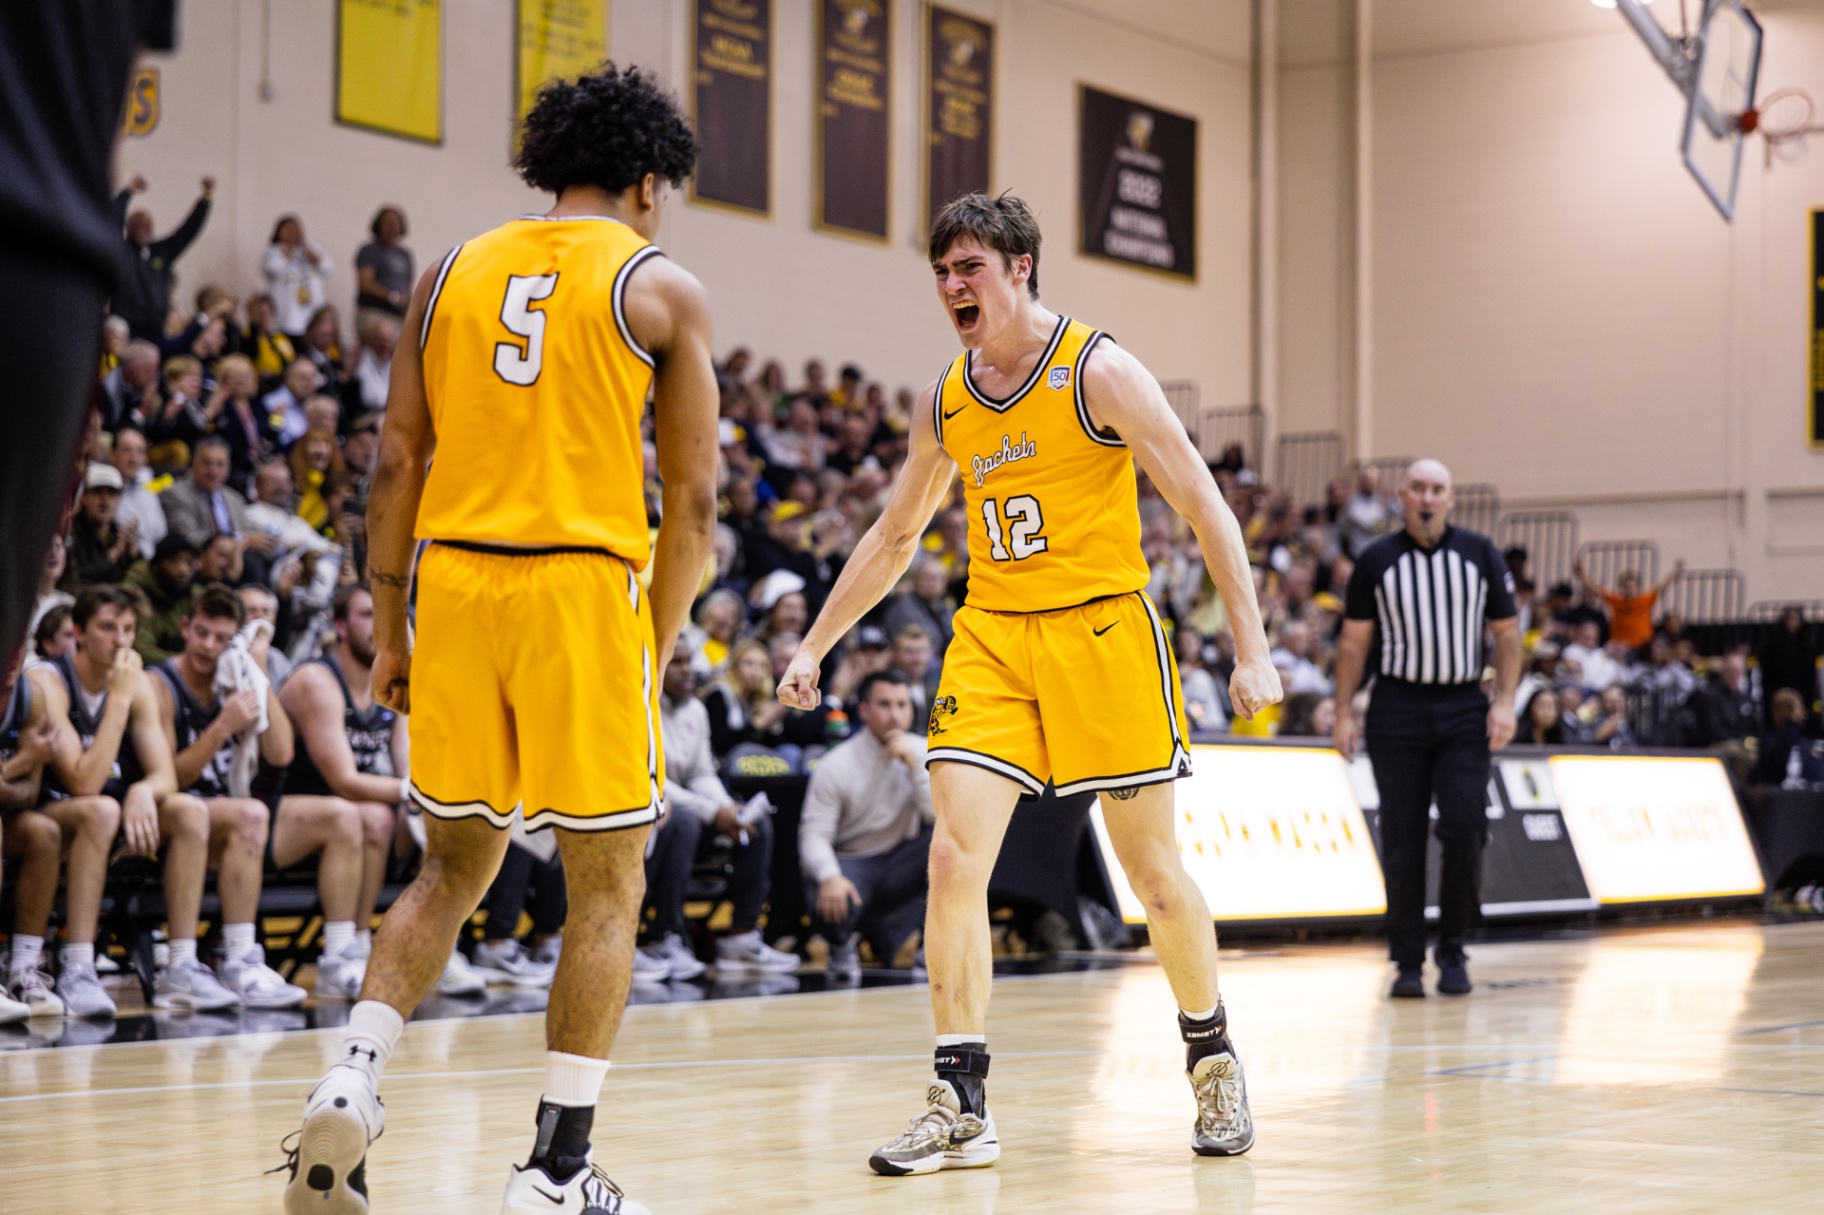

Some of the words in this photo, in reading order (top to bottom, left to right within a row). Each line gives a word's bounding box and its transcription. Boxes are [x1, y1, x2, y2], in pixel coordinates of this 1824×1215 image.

[493, 271, 560, 387] 5
[1053, 371, 1067, 382] 50
[972, 431, 1036, 488] Jackets
[982, 494, 1048, 561] 12
